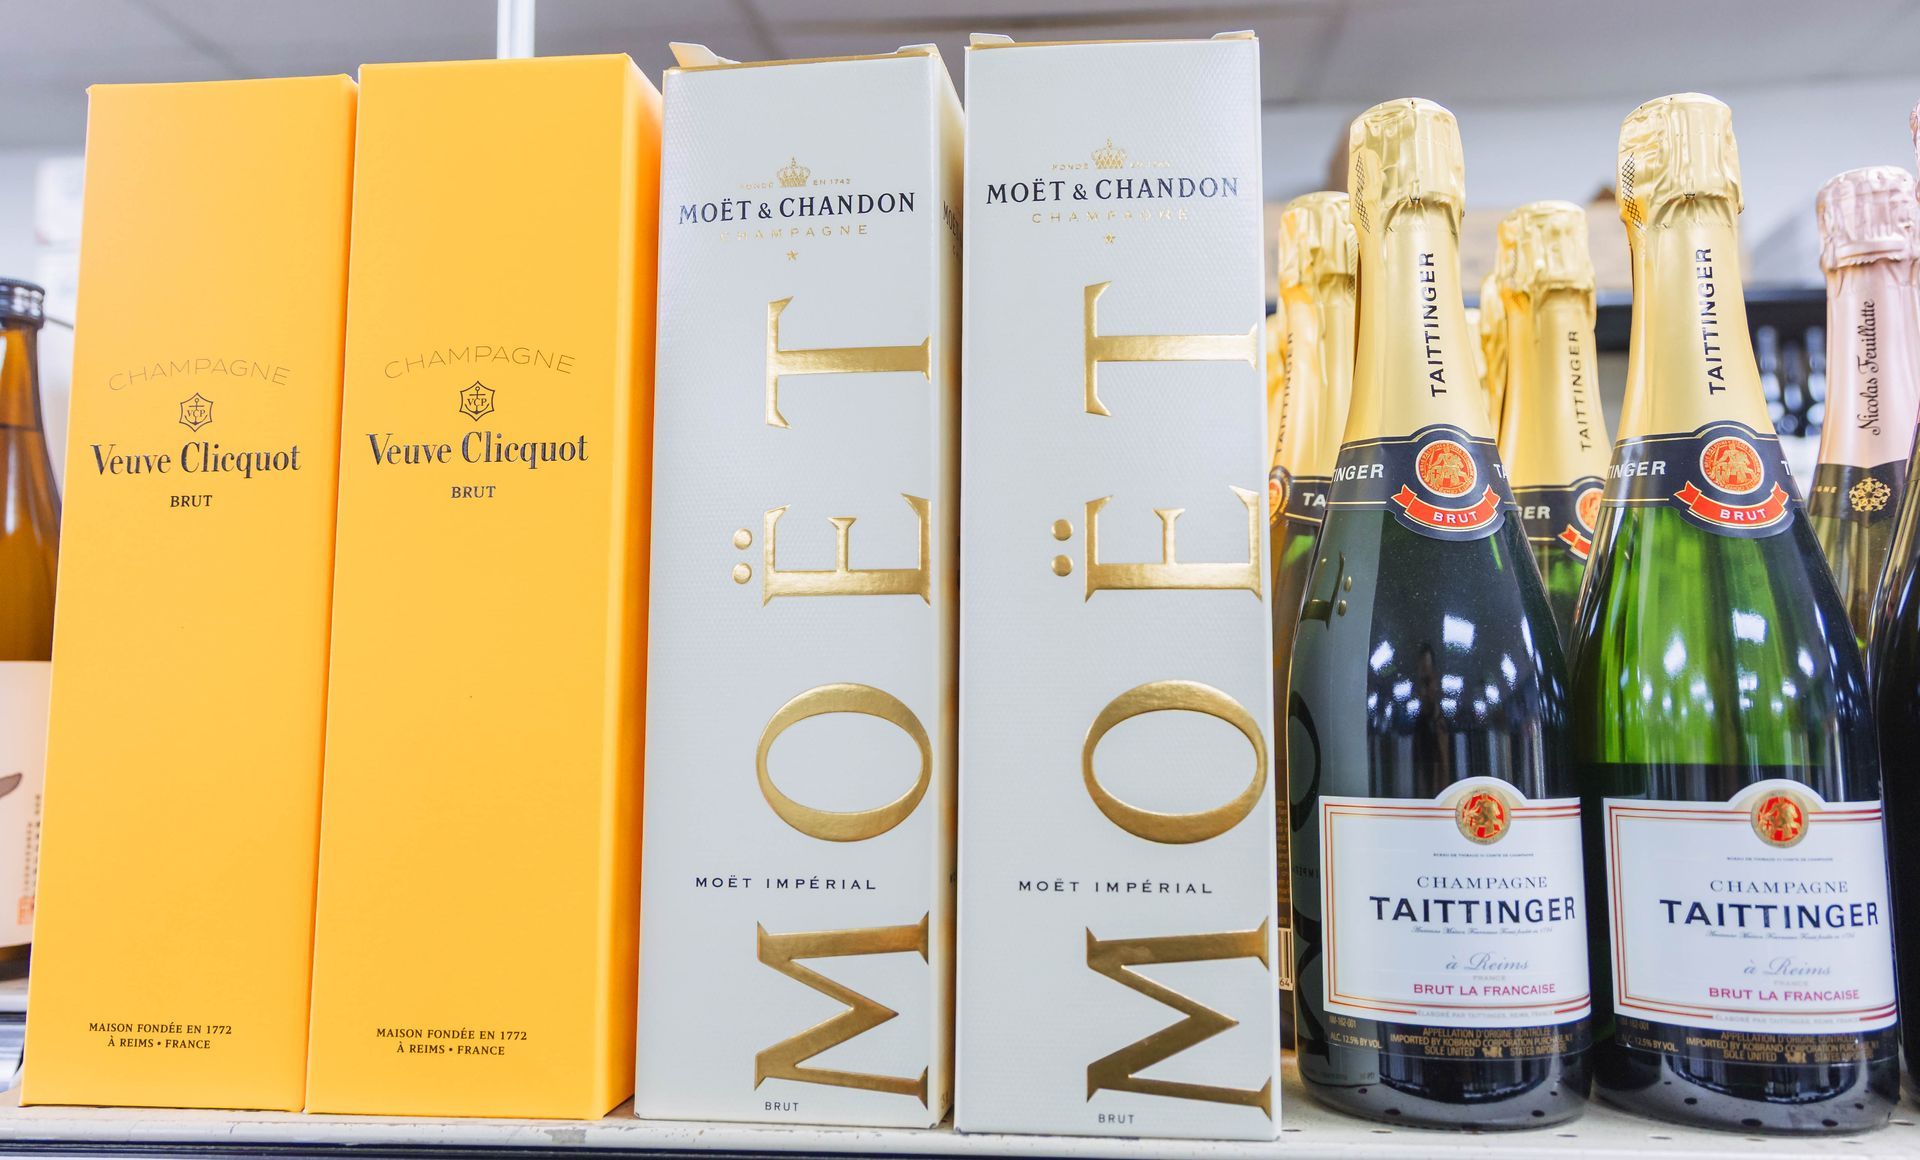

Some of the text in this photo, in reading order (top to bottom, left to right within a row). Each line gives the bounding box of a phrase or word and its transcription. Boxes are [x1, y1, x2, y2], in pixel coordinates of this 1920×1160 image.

[986, 177, 1239, 204] MOËT & CHANDON
[679, 192, 915, 224] MOËT & CHANDON
[720, 224, 868, 241] CHAMPAGNE
[1419, 252, 1447, 397] TAITTINGER
[1695, 247, 1726, 395] TAITTINGER
[384, 346, 576, 379] CHAMPAGNE
[1857, 299, 1880, 436] Nicolas Feuillatte
[109, 358, 291, 391] CHAMPAGNE
[1568, 331, 1592, 452] TAITTINGER
[366, 431, 589, 469] Veuve Clicquot
[90, 441, 302, 479] Veuve Clicquot
[451, 486, 496, 498] BRUT
[170, 495, 213, 507] BRUT
[1433, 511, 1478, 524] BRUT
[1720, 508, 1768, 521] BRUT
[731, 296, 933, 1111] MOËT
[1051, 280, 1272, 1122] MOËT
[696, 875, 876, 890] MOËT IMPÉRIAL
[1018, 878, 1212, 894] MOËT IMPÉRIAL
[1417, 876, 1548, 889] CHAMPAGNE
[1710, 880, 1848, 894] CHAMPAGNE
[1369, 896, 1575, 924] TAITTINGER
[1660, 899, 1879, 929] TAITTINGER
[1446, 952, 1529, 971] à Reims
[1743, 956, 1832, 976] à Reims
[1413, 984, 1556, 996] BRUT LA FRANCAISE
[1709, 987, 1860, 1001] BRUT LA FRANCAISE
[89, 1022, 232, 1035] MAISON FONDÉE EN 1772
[376, 1027, 527, 1041] MAISON FONDÉE EN 1772
[107, 1035, 211, 1049] À REIMS FRANCE
[1390, 1034, 1429, 1046] IMPORTED
[1431, 1037, 1442, 1047] BY
[1686, 1037, 1728, 1049] IMPORTED
[1730, 1041, 1741, 1050] BY
[396, 1041, 505, 1056] À REIMS FRANCE
[1424, 1046, 1444, 1056] SOLE
[1447, 1047, 1475, 1057] UNITED
[1748, 1051, 1776, 1062] UNITED
[765, 1101, 800, 1112] BRUT
[1098, 1113, 1135, 1124] BRUT
